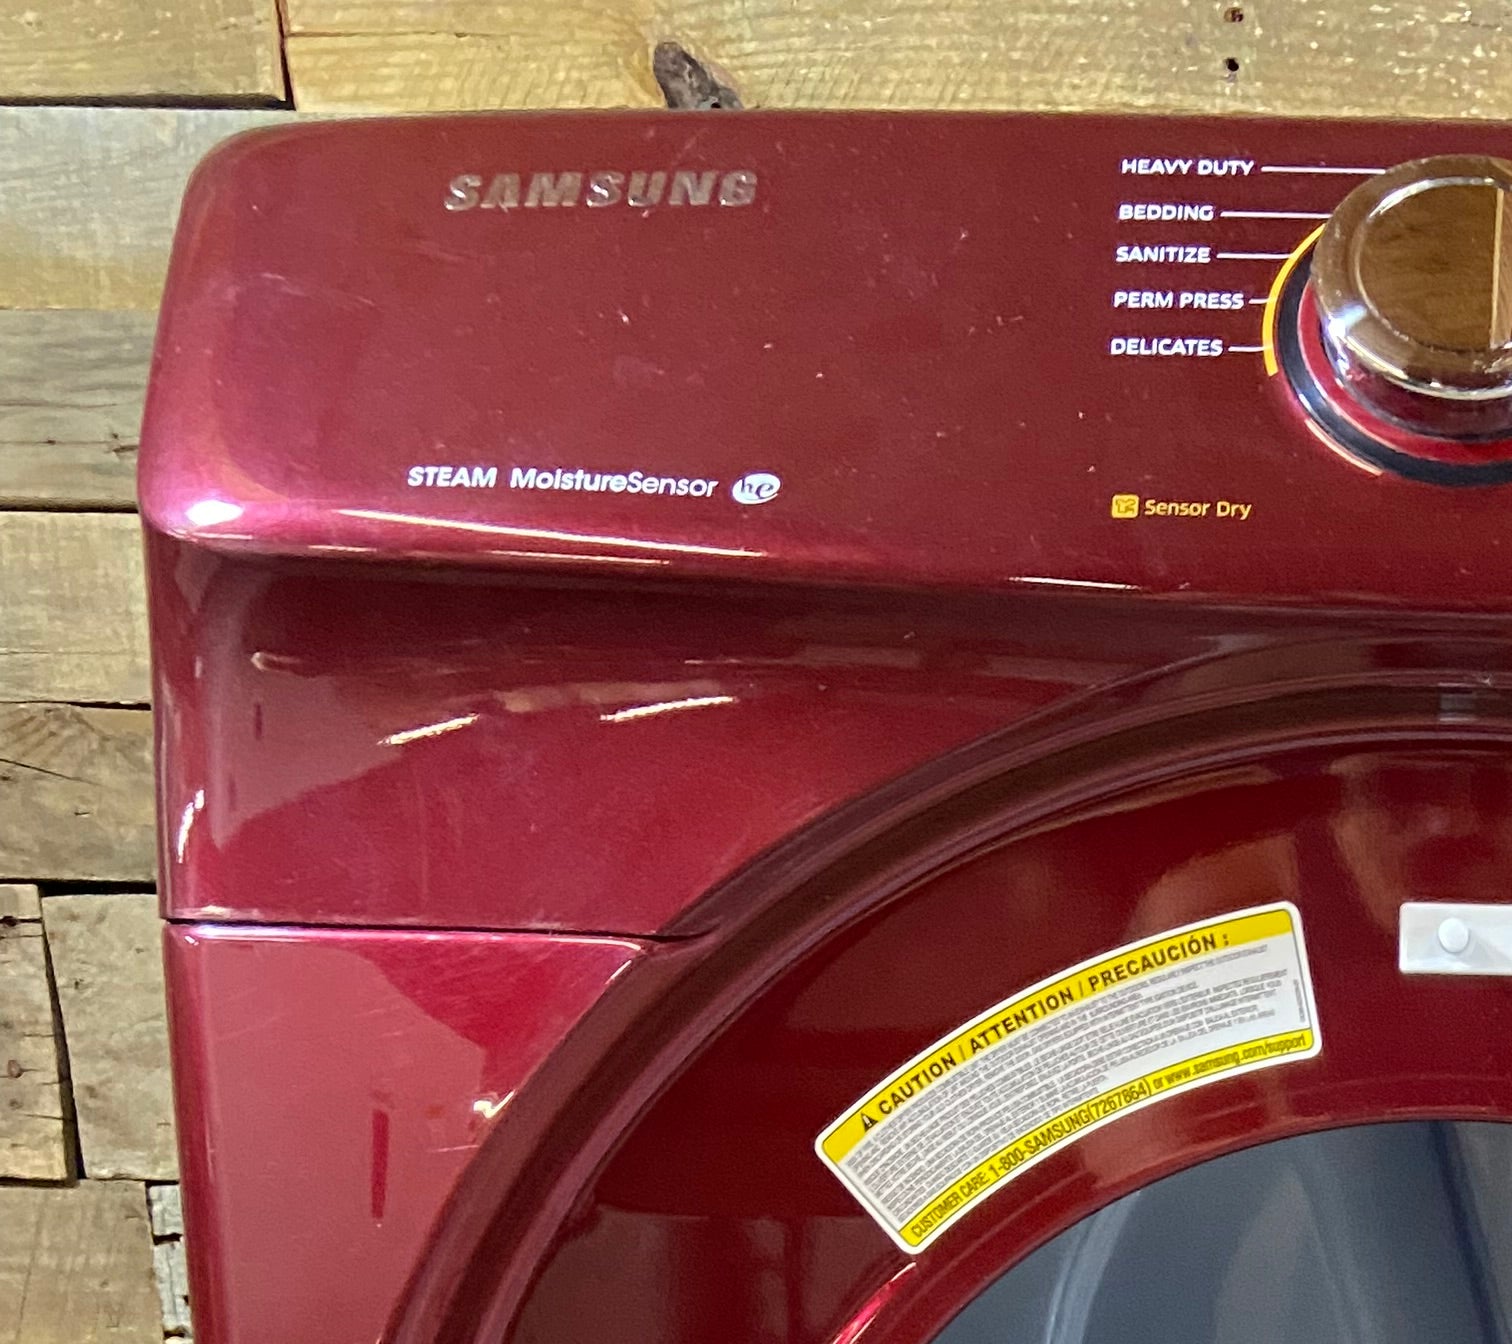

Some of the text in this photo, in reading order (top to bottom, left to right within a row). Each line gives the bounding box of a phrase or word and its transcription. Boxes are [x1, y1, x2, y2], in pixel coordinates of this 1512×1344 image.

[1121, 158, 1255, 177] HEAVY DUTY
[444, 170, 758, 211] SAMSUNG
[1118, 203, 1215, 222] BEDDING
[1115, 245, 1212, 264] SANITIZE
[1113, 291, 1245, 310] PERM PRESS
[1110, 338, 1224, 357] DELICATES
[408, 465, 498, 489] STEAM
[509, 467, 719, 499] MoistureSensor
[1144, 499, 1253, 521] Sensor Dry
[878, 1054, 959, 1116] CAUTION
[969, 985, 1075, 1056] ATTENTION
[1088, 932, 1218, 993] PRECAUCIÓN
[911, 1189, 961, 1239] CUSTOMER
